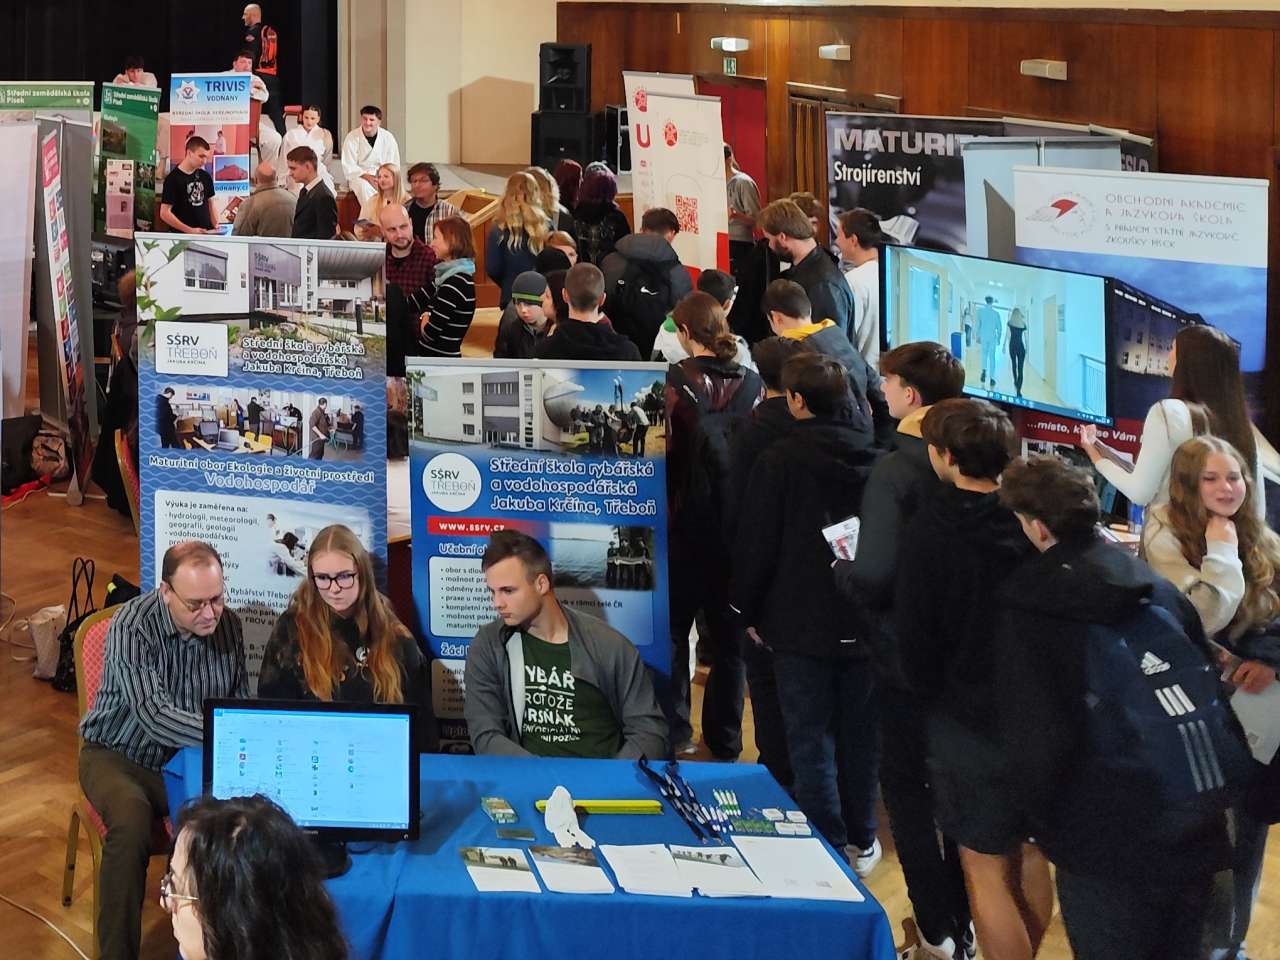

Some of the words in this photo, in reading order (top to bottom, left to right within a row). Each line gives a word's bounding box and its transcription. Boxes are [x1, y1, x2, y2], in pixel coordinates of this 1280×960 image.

[6, 89, 31, 97] Střední
[32, 89, 71, 97] zemědělská
[205, 81, 245, 92] TRIVIS
[834, 160, 922, 187] Strojírenství
[166, 331, 199, 345] SŠRV
[242, 337, 283, 350] Střední
[284, 339, 315, 352] škola
[316, 340, 365, 356] rybářská
[243, 350, 251, 359] a
[252, 348, 347, 367] vodohospodářská
[242, 361, 282, 374] Jakuba
[284, 362, 322, 377] Krčína,
[323, 365, 363, 379] Třeboň
[1112, 429, 1136, 443] Vám
[149, 456, 198, 470] Maturitní
[200, 458, 225, 471] obor
[227, 462, 273, 475] Ekologie
[275, 467, 282, 475] a
[283, 465, 320, 479] životní
[323, 468, 374, 483] prostředí
[431, 468, 460, 479] SŠRV
[490, 457, 545, 473] Střední
[546, 459, 585, 475] škola
[589, 461, 654, 479] rybářská
[205, 472, 316, 493] Vodohospodář
[491, 480, 500, 491] a
[505, 477, 637, 496] vodohospodářská
[165, 499, 189, 511] Výuka
[190, 501, 197, 511] je
[199, 502, 236, 513] zaměřena
[237, 505, 248, 513] na:
[491, 496, 545, 512] Jakuba
[548, 498, 601, 515] Krčína,
[604, 500, 657, 515] Třeboň
[169, 529, 238, 542] vodohospodářskou
[439, 542, 476, 555] Učební
[226, 597, 265, 606] tanického
[440, 640, 464, 656] Žáci
[525, 665, 576, 690] YBÁŘ
[525, 692, 573, 710] ROTOŽE
[525, 708, 576, 727] RSŇÁK
